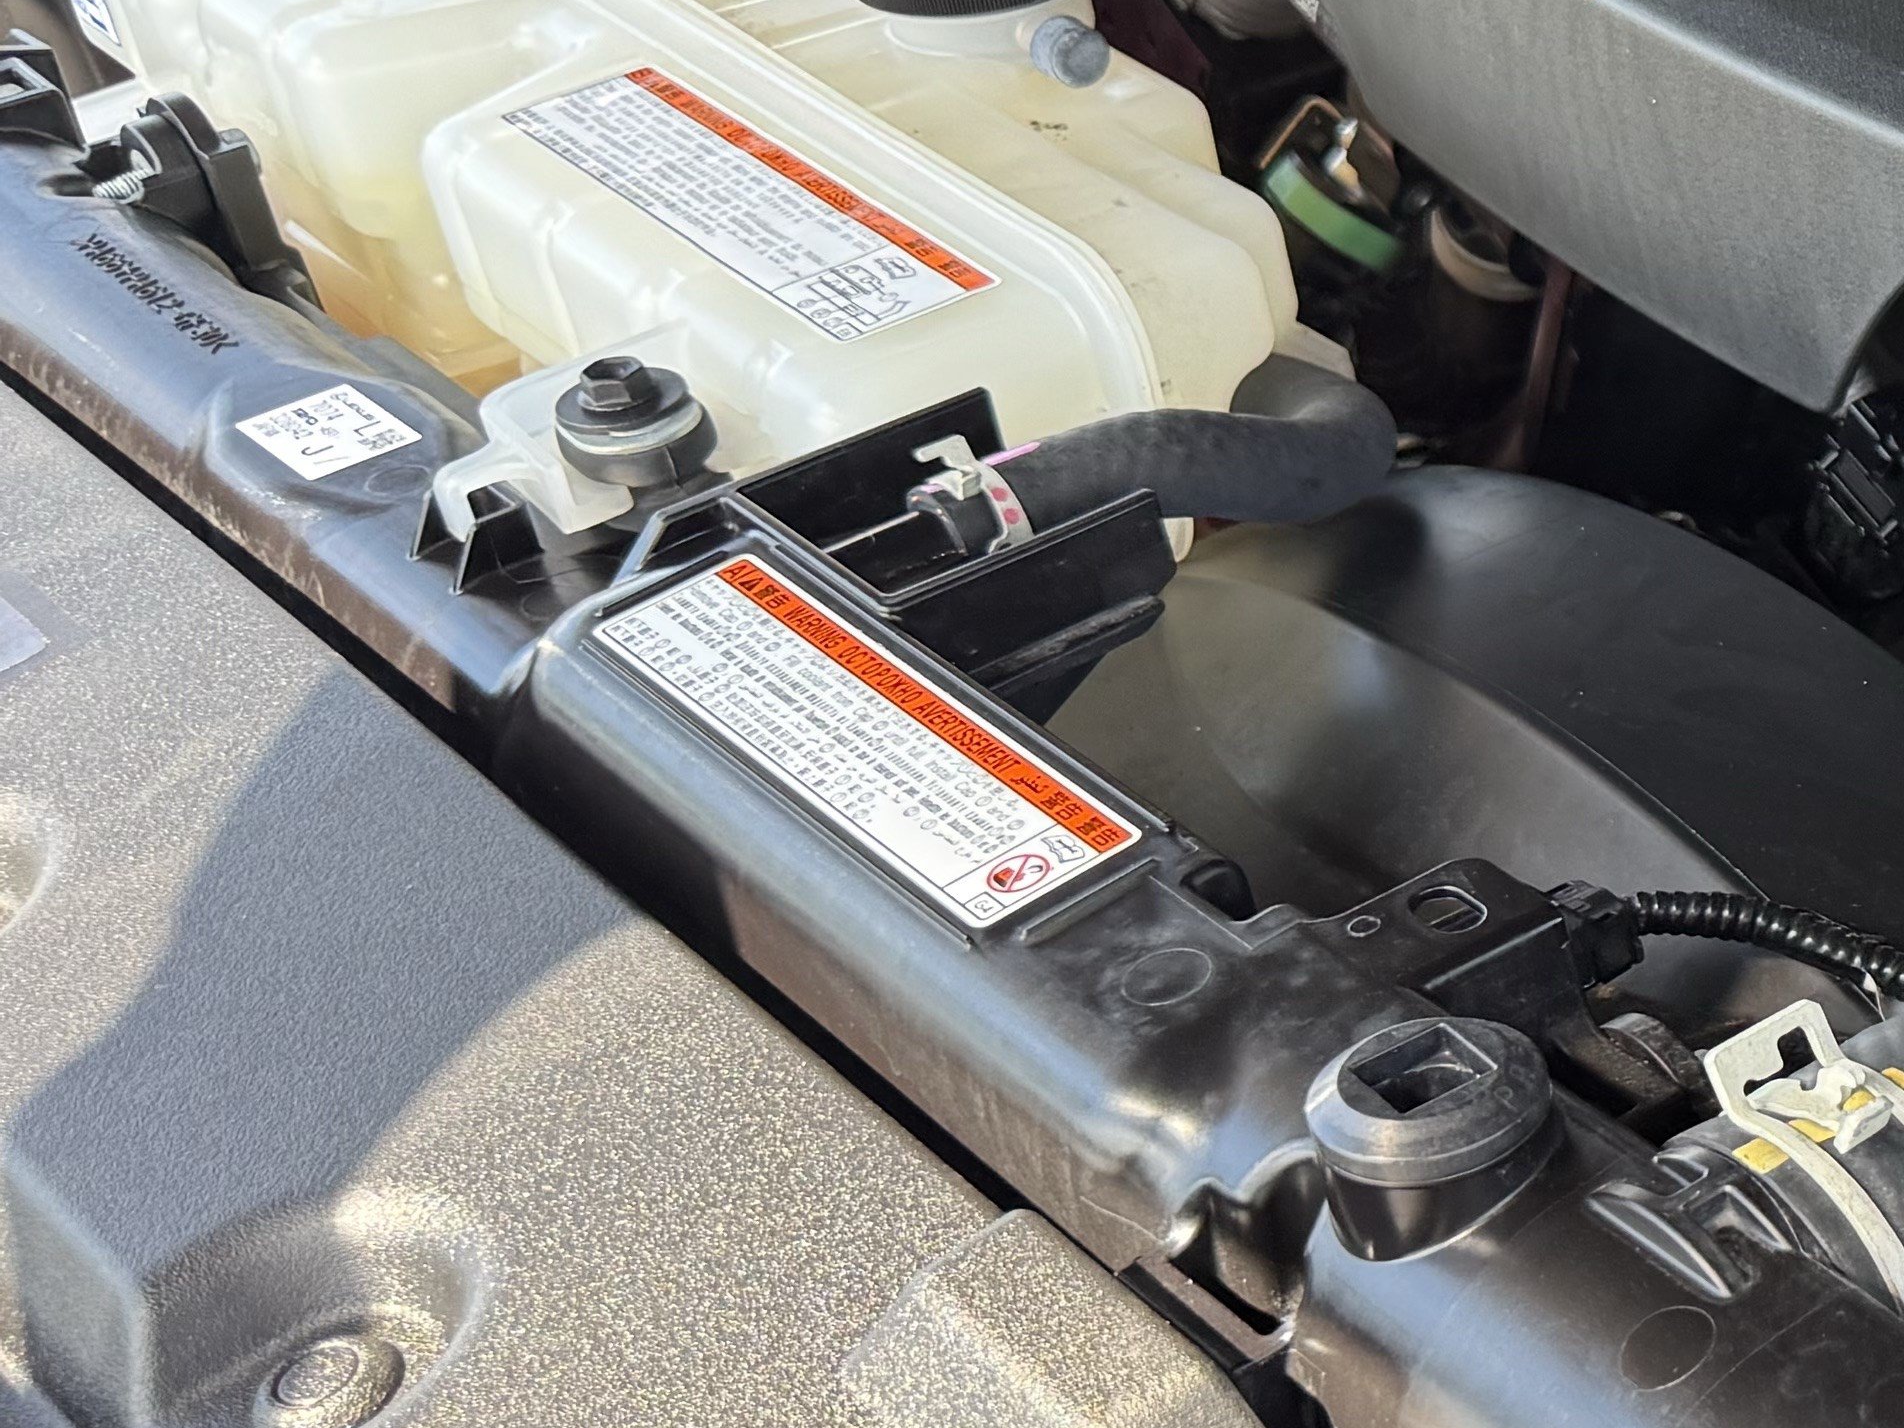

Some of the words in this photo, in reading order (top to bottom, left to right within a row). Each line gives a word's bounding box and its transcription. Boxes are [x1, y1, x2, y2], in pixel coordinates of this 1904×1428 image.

[780, 605, 849, 650] WARNING
[835, 644, 925, 705] ОСТОРОЖНО
[910, 698, 1022, 776] AVERTISSEMENT
